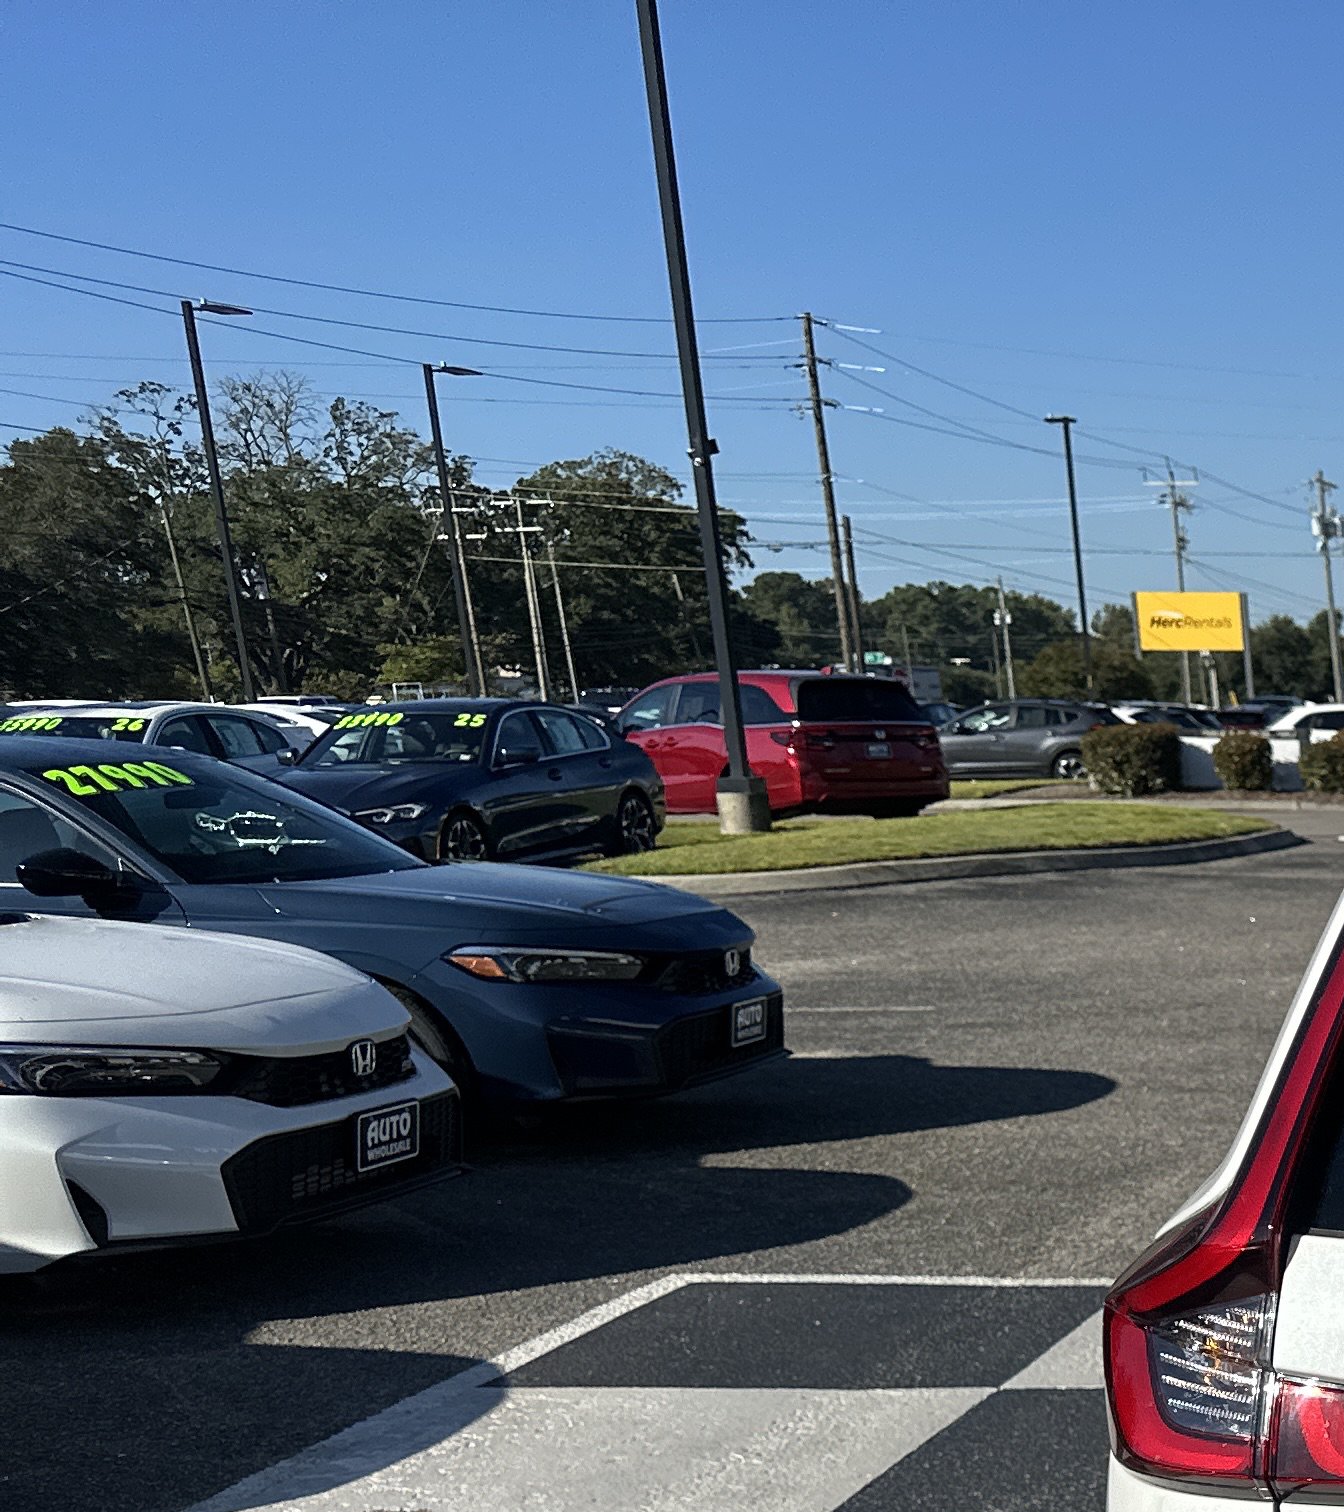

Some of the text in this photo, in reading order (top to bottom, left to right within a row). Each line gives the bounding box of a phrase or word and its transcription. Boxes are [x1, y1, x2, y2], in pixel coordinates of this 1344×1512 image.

[111, 718, 145, 731] 26
[453, 713, 487, 728] 25
[42, 761, 194, 796] 27990
[366, 1111, 412, 1149] AUTO
